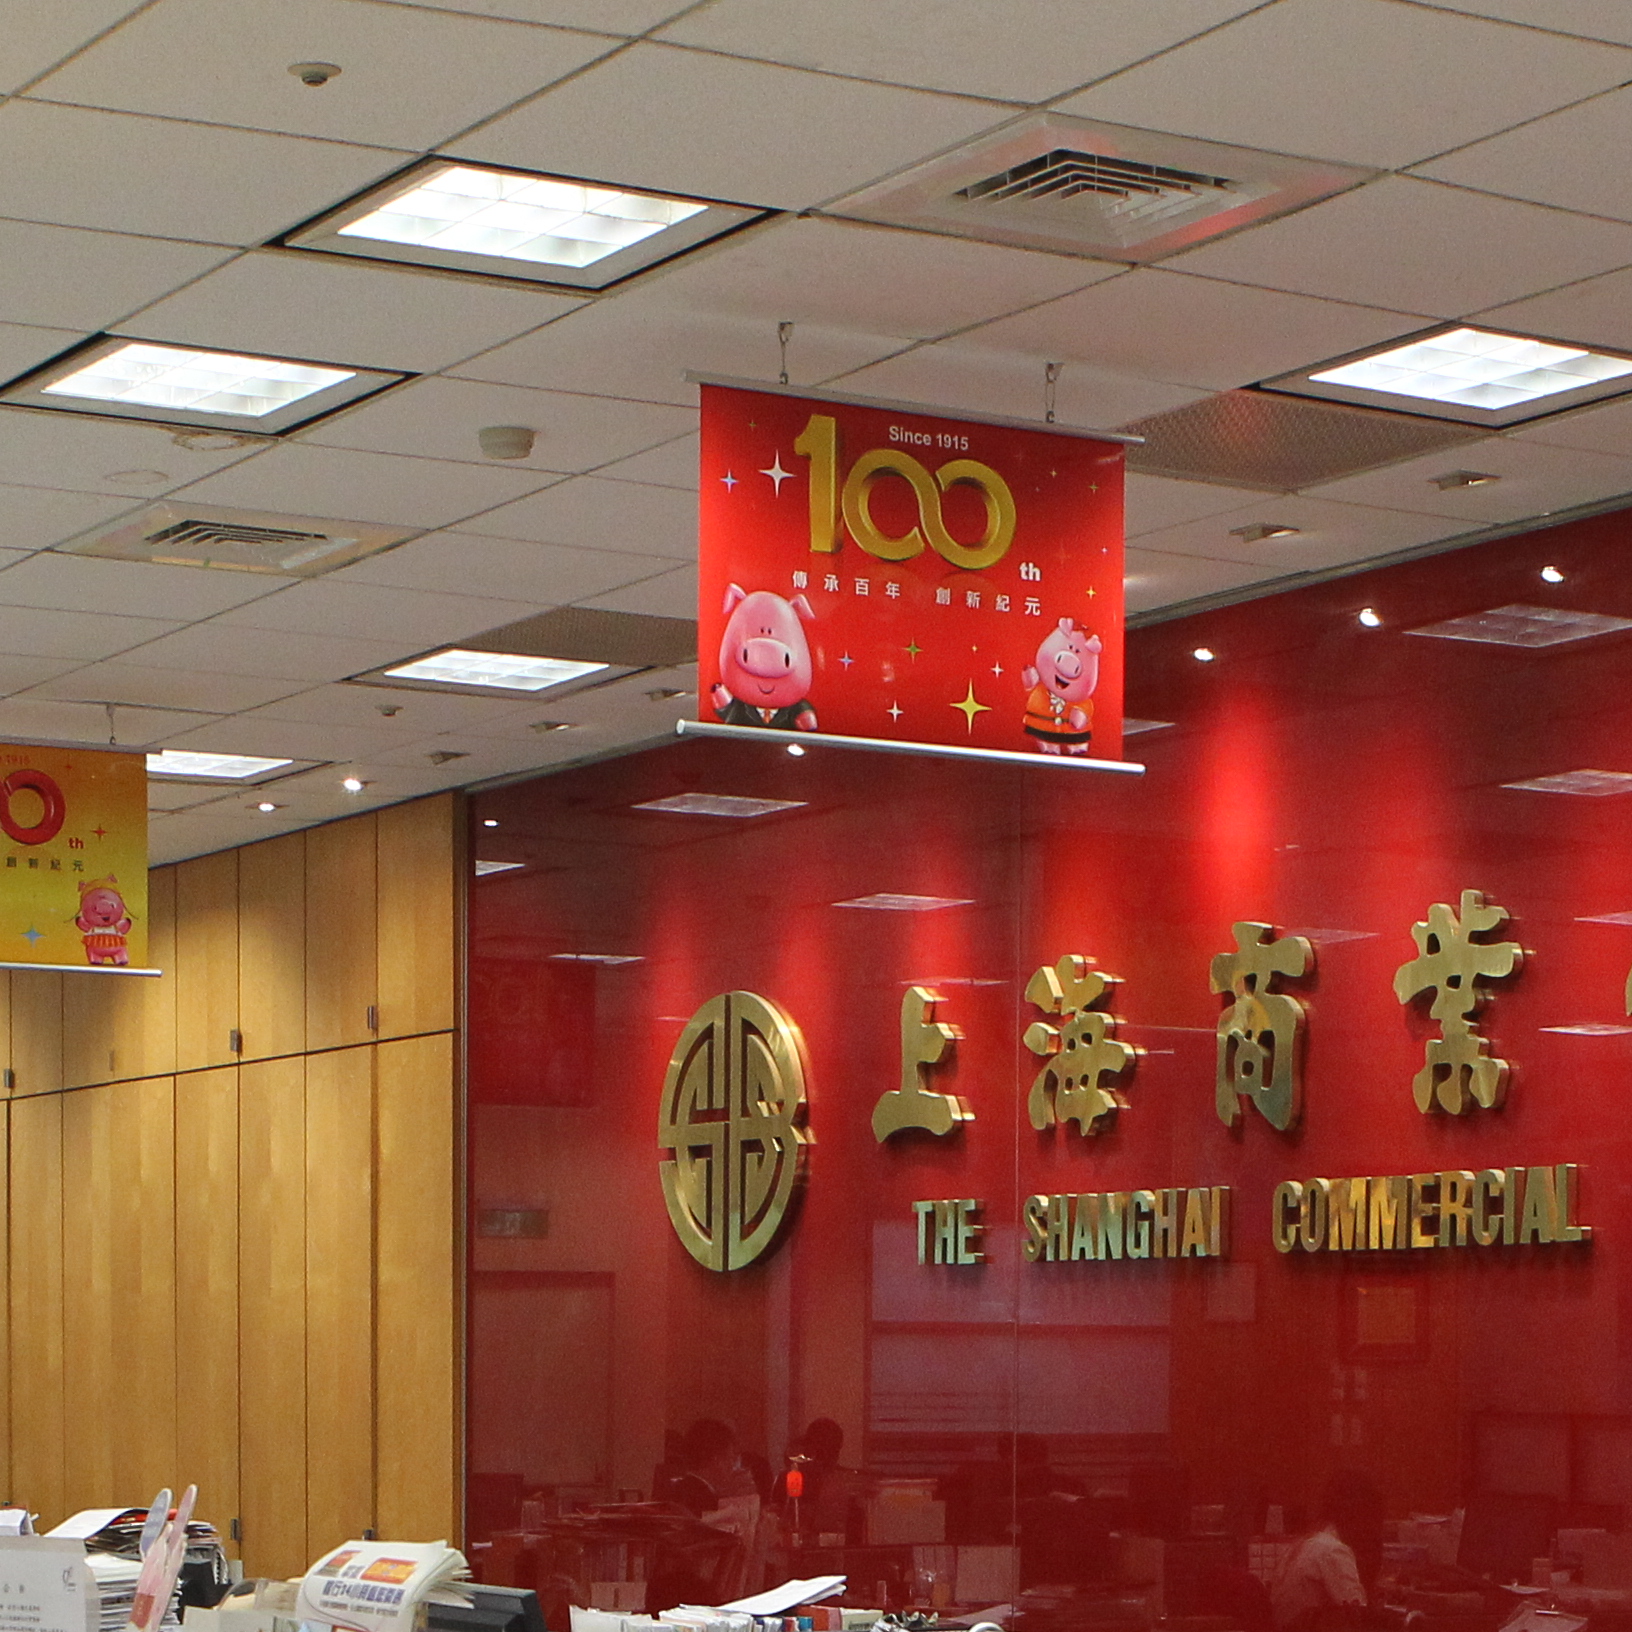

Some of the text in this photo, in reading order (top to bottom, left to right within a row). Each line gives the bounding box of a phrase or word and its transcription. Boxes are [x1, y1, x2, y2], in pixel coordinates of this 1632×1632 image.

[889, 425, 969, 451] Since 1915
[794, 414, 1041, 582] 100 th
[792, 570, 1041, 616] 傳承百年 創新紀元
[69, 838, 84, 849] th
[913, 1199, 986, 1265] THE
[1023, 1185, 1230, 1262] SHANGHAI
[1273, 1162, 1591, 1254] COMMERCIAL
